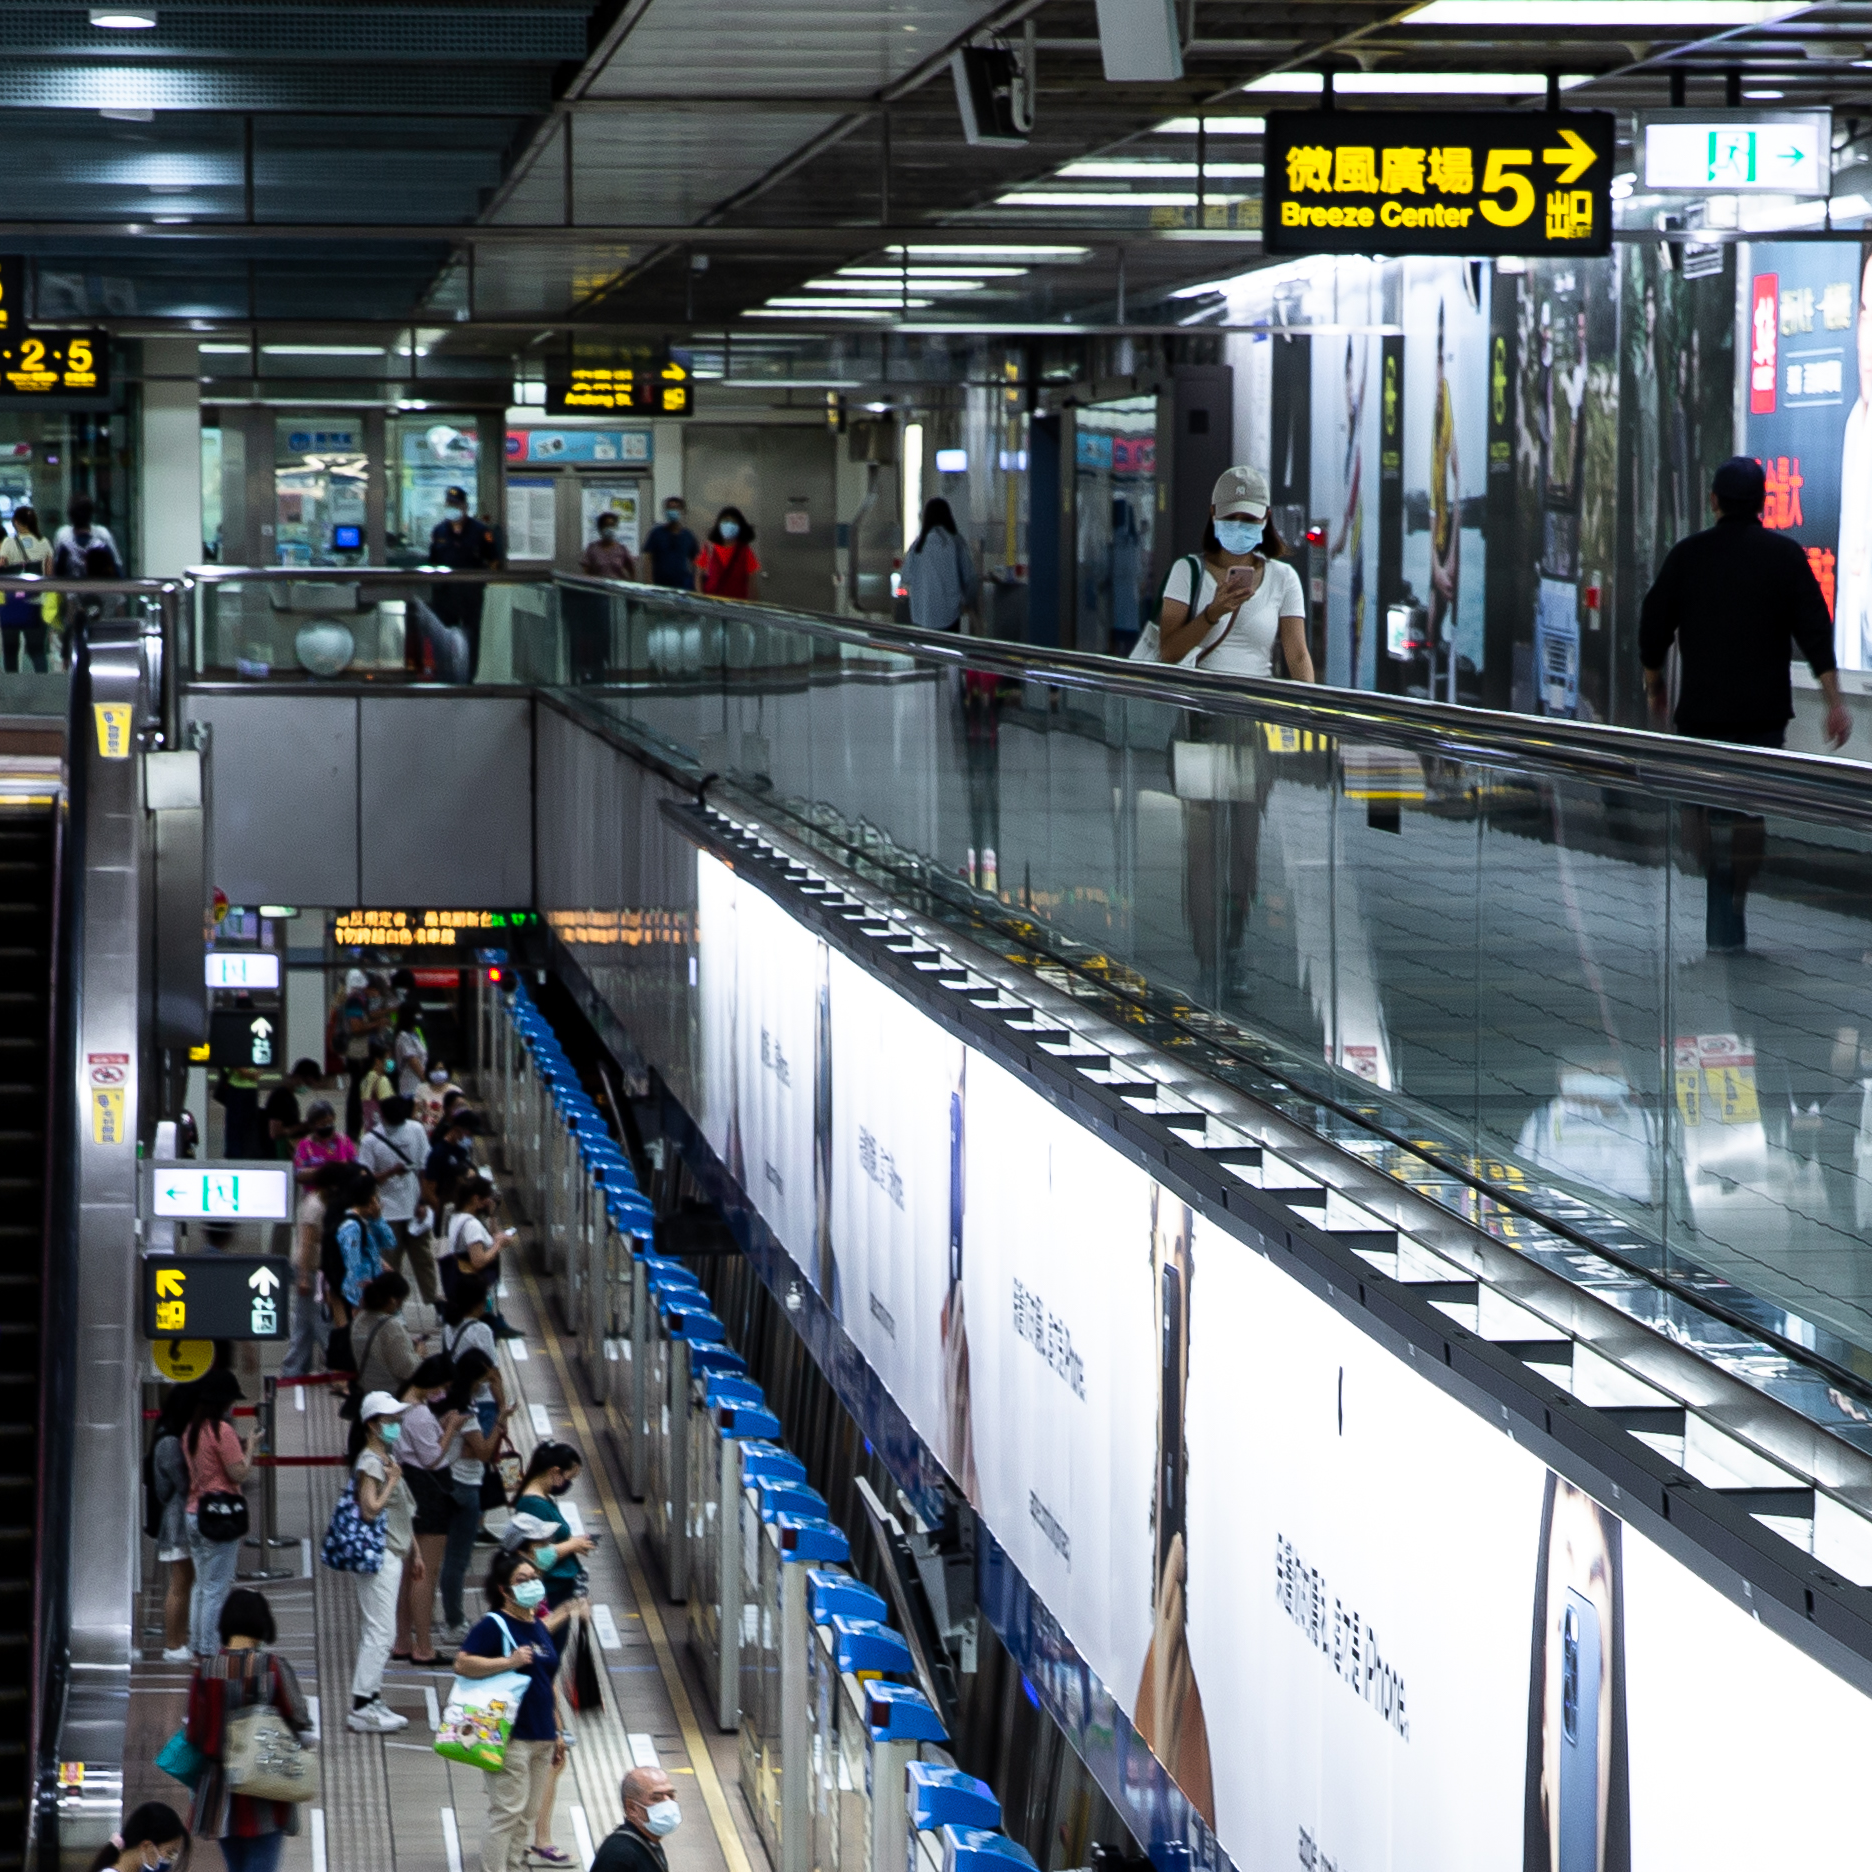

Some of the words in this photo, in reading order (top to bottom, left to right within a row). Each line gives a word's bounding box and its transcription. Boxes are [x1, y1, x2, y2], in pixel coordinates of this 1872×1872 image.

[1285, 146, 1475, 195] 微風廣場
[1479, 149, 1537, 228] 5
[1279, 201, 1376, 228] Breeze
[1378, 201, 1475, 228] Center
[20, 339, 45, 371] 2
[67, 339, 93, 372] 5
